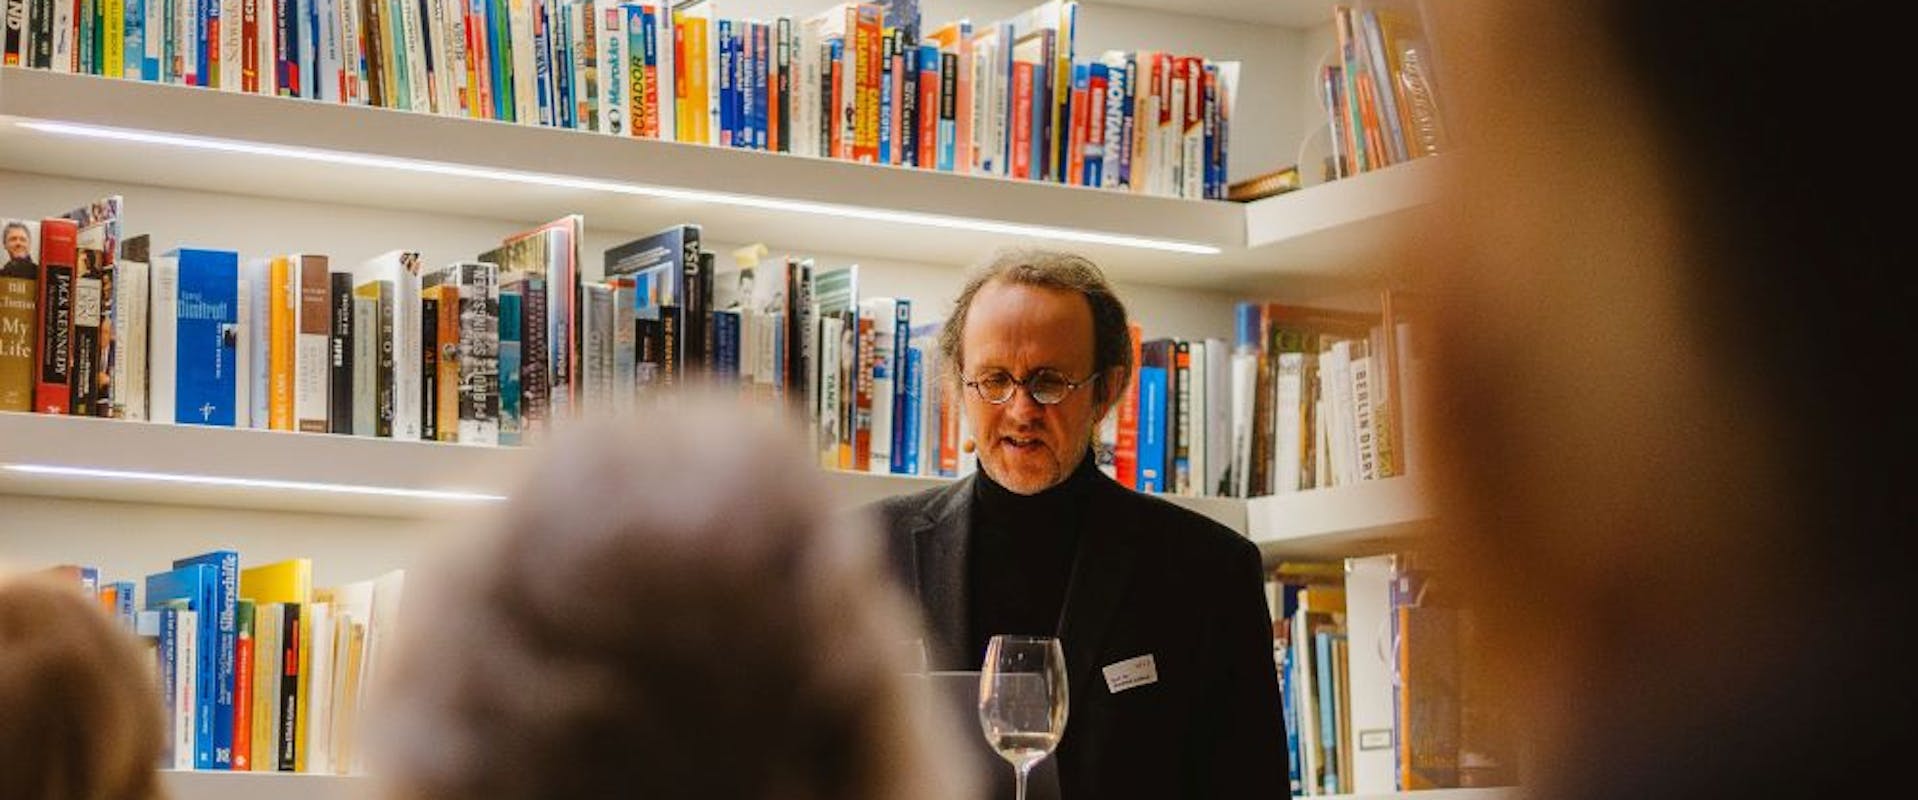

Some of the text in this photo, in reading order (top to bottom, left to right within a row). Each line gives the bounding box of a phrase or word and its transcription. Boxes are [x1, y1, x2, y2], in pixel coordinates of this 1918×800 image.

[607, 37, 620, 107] Marokko
[1105, 68, 1125, 161] MONTANA
[684, 239, 700, 275] USA
[0, 297, 36, 309] linton
[3, 321, 29, 346] My
[55, 273, 71, 376] JACK KENNEDY
[471, 270, 487, 402] BRUCE SPRINGSTEEN
[0, 345, 32, 364] Life
[333, 338, 343, 368] PIPER
[1355, 370, 1374, 481] BERLIN DIARY
[219, 554, 236, 632] Silberschiffe
